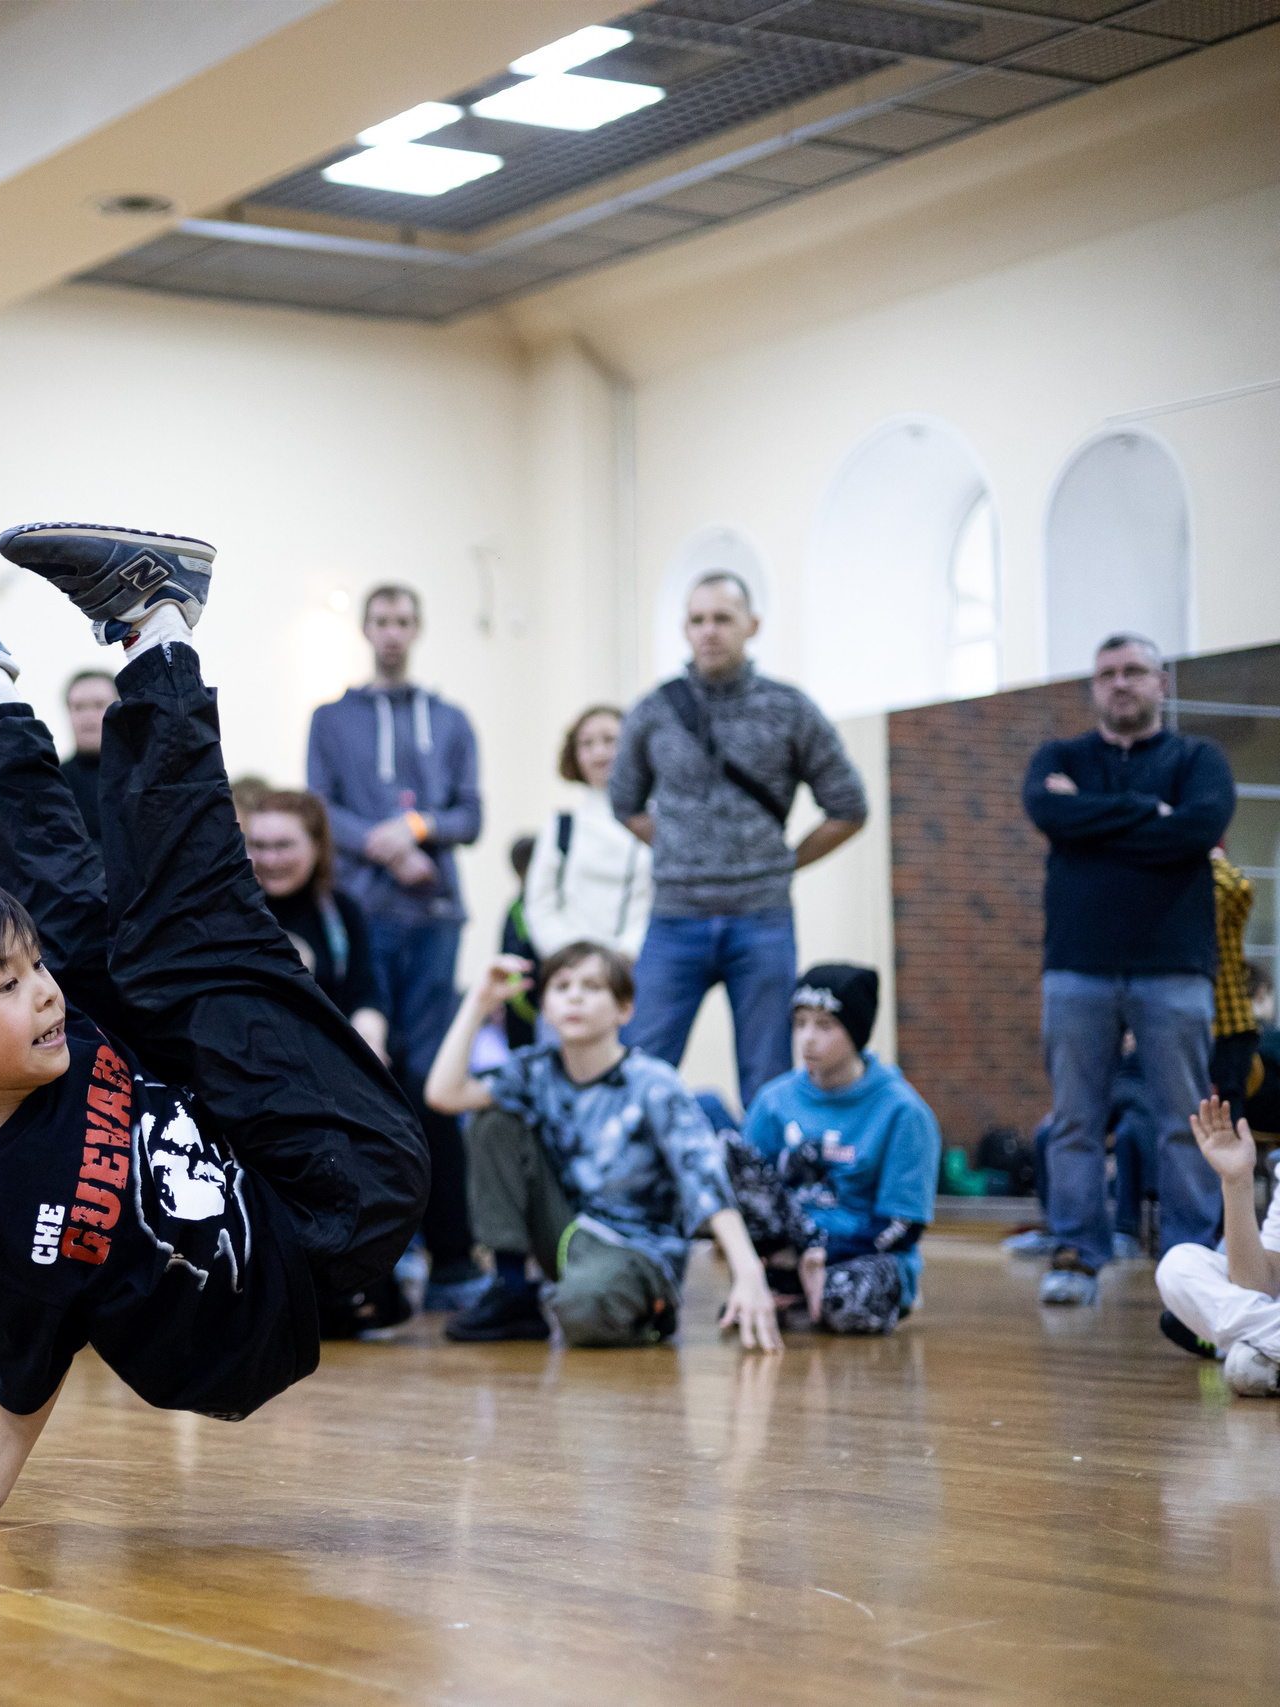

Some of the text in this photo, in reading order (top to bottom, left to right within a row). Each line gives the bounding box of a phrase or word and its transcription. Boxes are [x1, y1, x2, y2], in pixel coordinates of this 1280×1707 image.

[119, 555, 169, 591] N
[61, 1027, 133, 1266] GUEVAR
[31, 1203, 66, 1265] CHE
